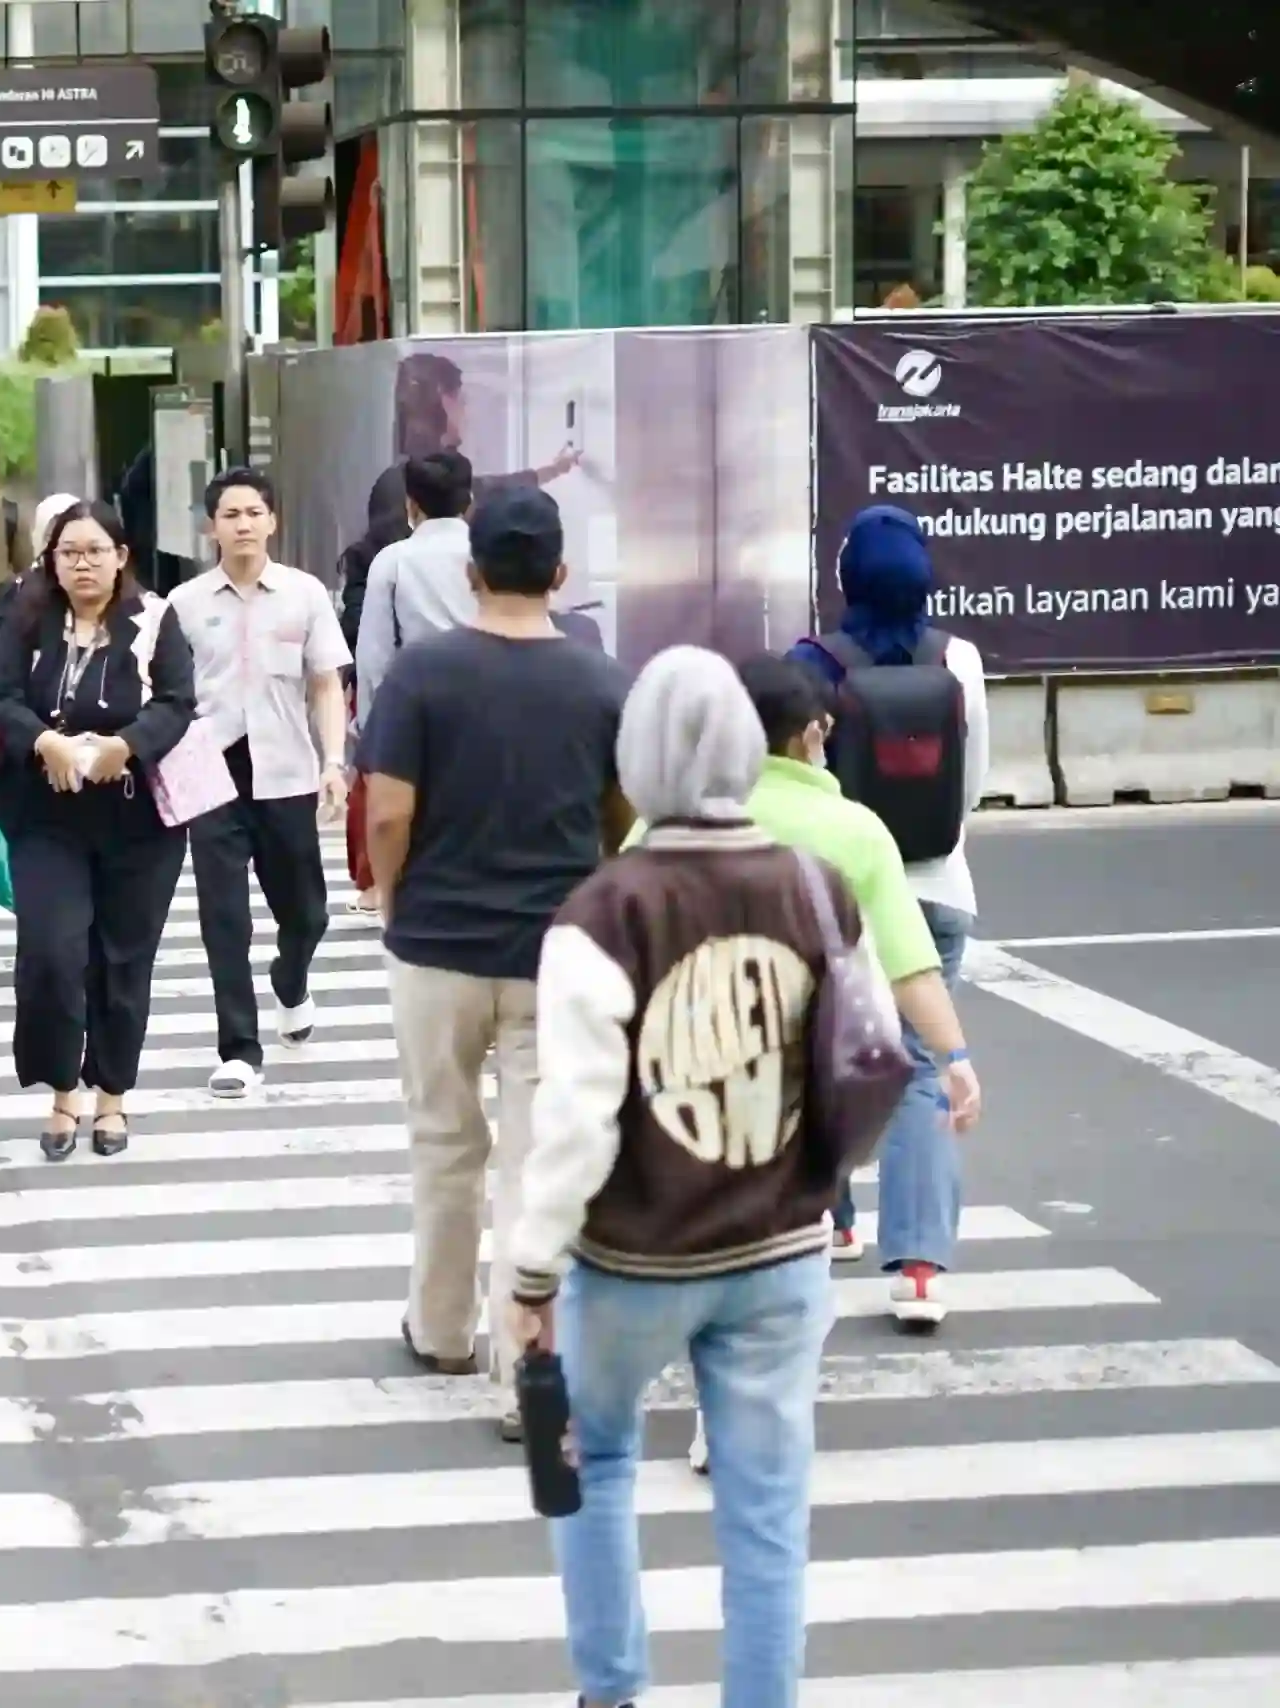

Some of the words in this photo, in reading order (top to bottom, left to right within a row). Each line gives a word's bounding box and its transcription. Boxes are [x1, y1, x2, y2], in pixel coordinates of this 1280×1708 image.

[57, 86, 98, 101] ASTRA
[869, 464, 994, 494] Fasilitas
[1002, 462, 1083, 491] Halte
[1091, 459, 1198, 493] sedang
[1055, 503, 1213, 540] perjalanan
[1026, 583, 1149, 621] layanan
[1160, 577, 1235, 610] kami
